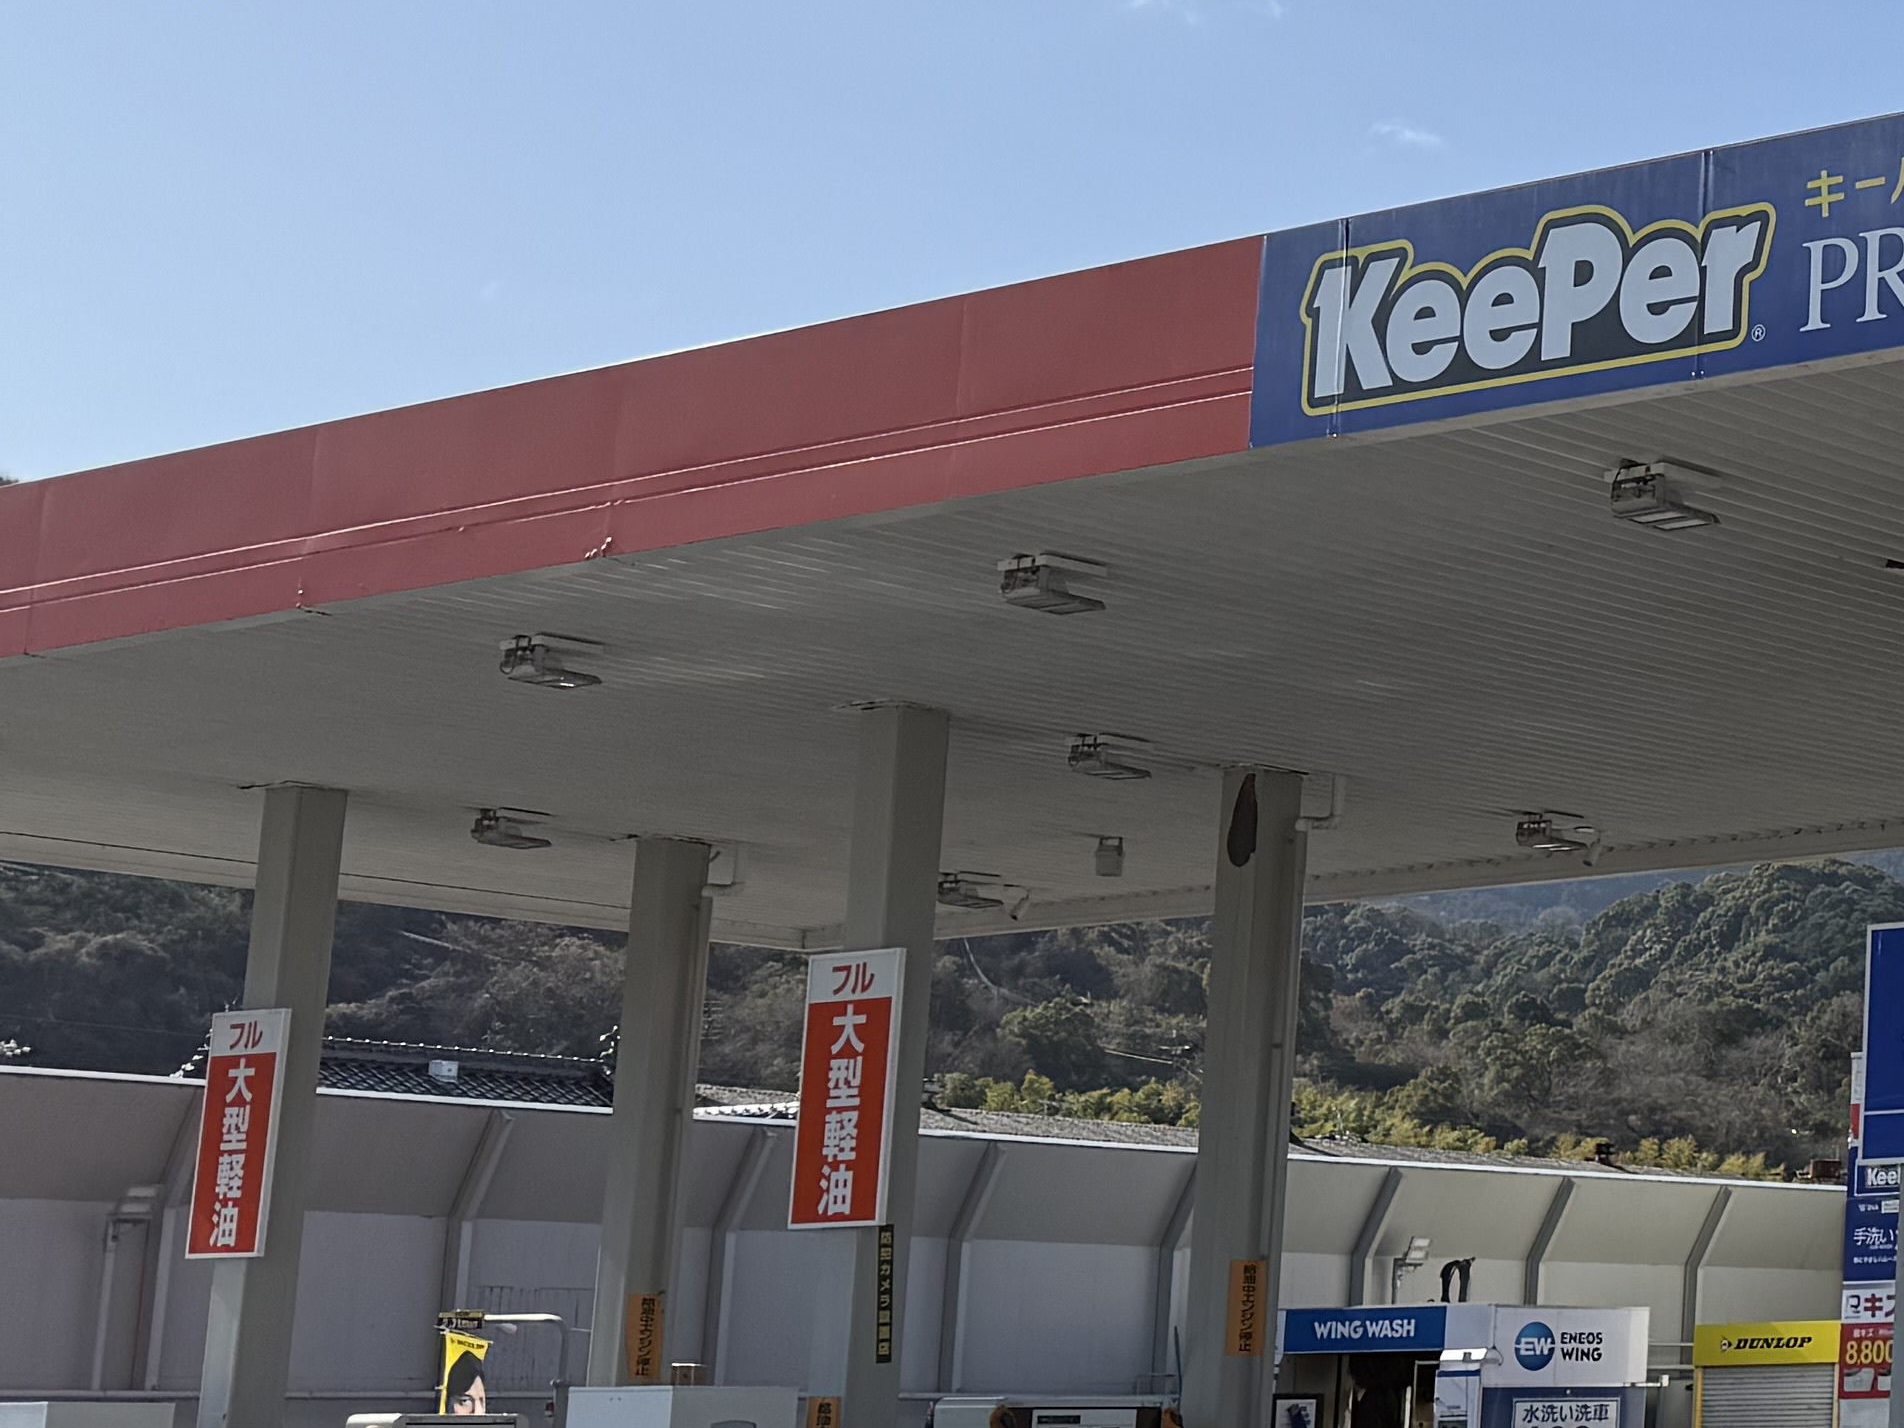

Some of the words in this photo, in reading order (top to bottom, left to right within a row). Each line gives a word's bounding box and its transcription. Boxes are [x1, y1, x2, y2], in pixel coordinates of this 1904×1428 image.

[1308, 214, 1767, 404] KeePer
[831, 963, 875, 995] フル
[229, 1022, 263, 1050] フル
[818, 1005, 868, 1216] 大型軽油
[208, 1059, 258, 1249] 大型軽油
[1867, 1166, 1900, 1186] Kee
[1314, 1320, 1363, 1340] WING
[1365, 1319, 1416, 1338] WASH
[1560, 1331, 1603, 1345] ENEOS
[1520, 1336, 1552, 1355] EW
[1560, 1346, 1603, 1362] WING
[1734, 1336, 1813, 1351] DUNLOP
[1522, 1402, 1610, 1424] 水洗い洗車
